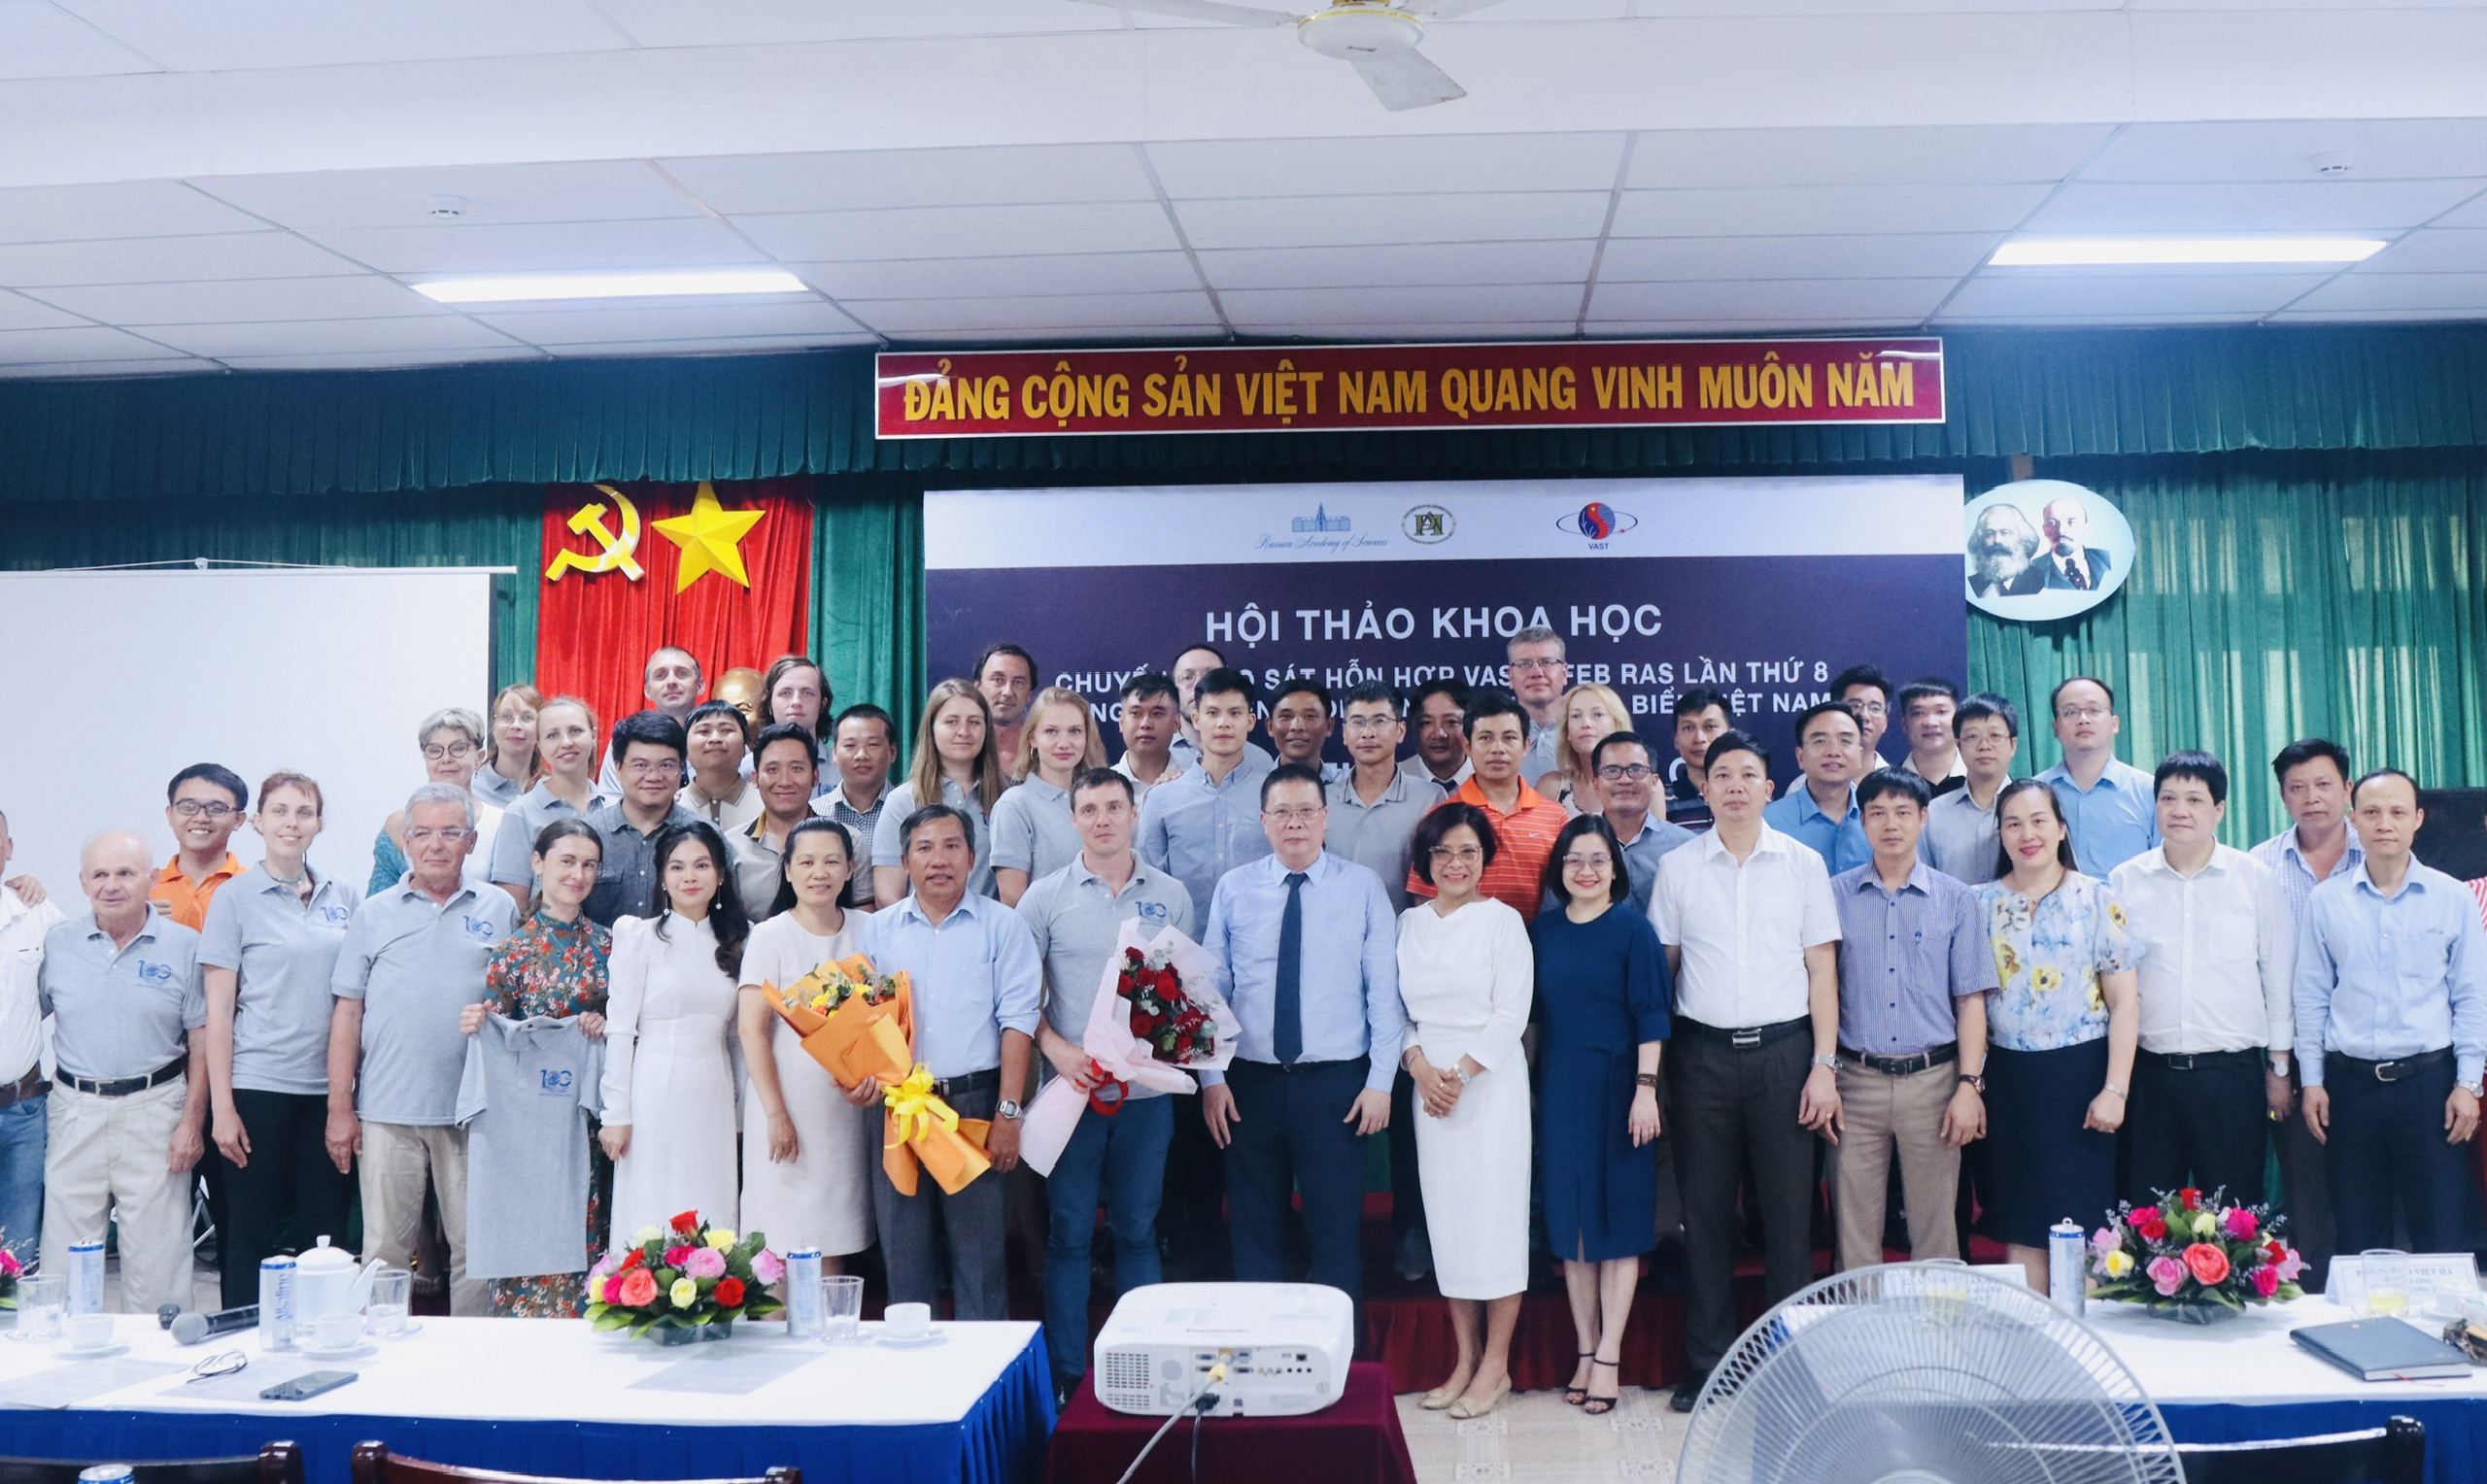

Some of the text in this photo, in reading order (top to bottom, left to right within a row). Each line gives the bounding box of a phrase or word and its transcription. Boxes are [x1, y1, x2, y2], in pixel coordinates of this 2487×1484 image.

[903, 352, 1914, 425] ĐẢNG CỘNG SẢN VIỆT NAM QUANG VINH MUÔN NĂM
[1294, 534, 1341, 554] Academy
[1206, 600, 1661, 648] HỘI THẢO KHOA HỌC
[1620, 663, 1674, 685] RAS
[1684, 656, 1736, 684] LẦN
[1746, 657, 1804, 683] THỨ
[1814, 661, 1829, 683] 8
[1772, 691, 1832, 713] NAM
